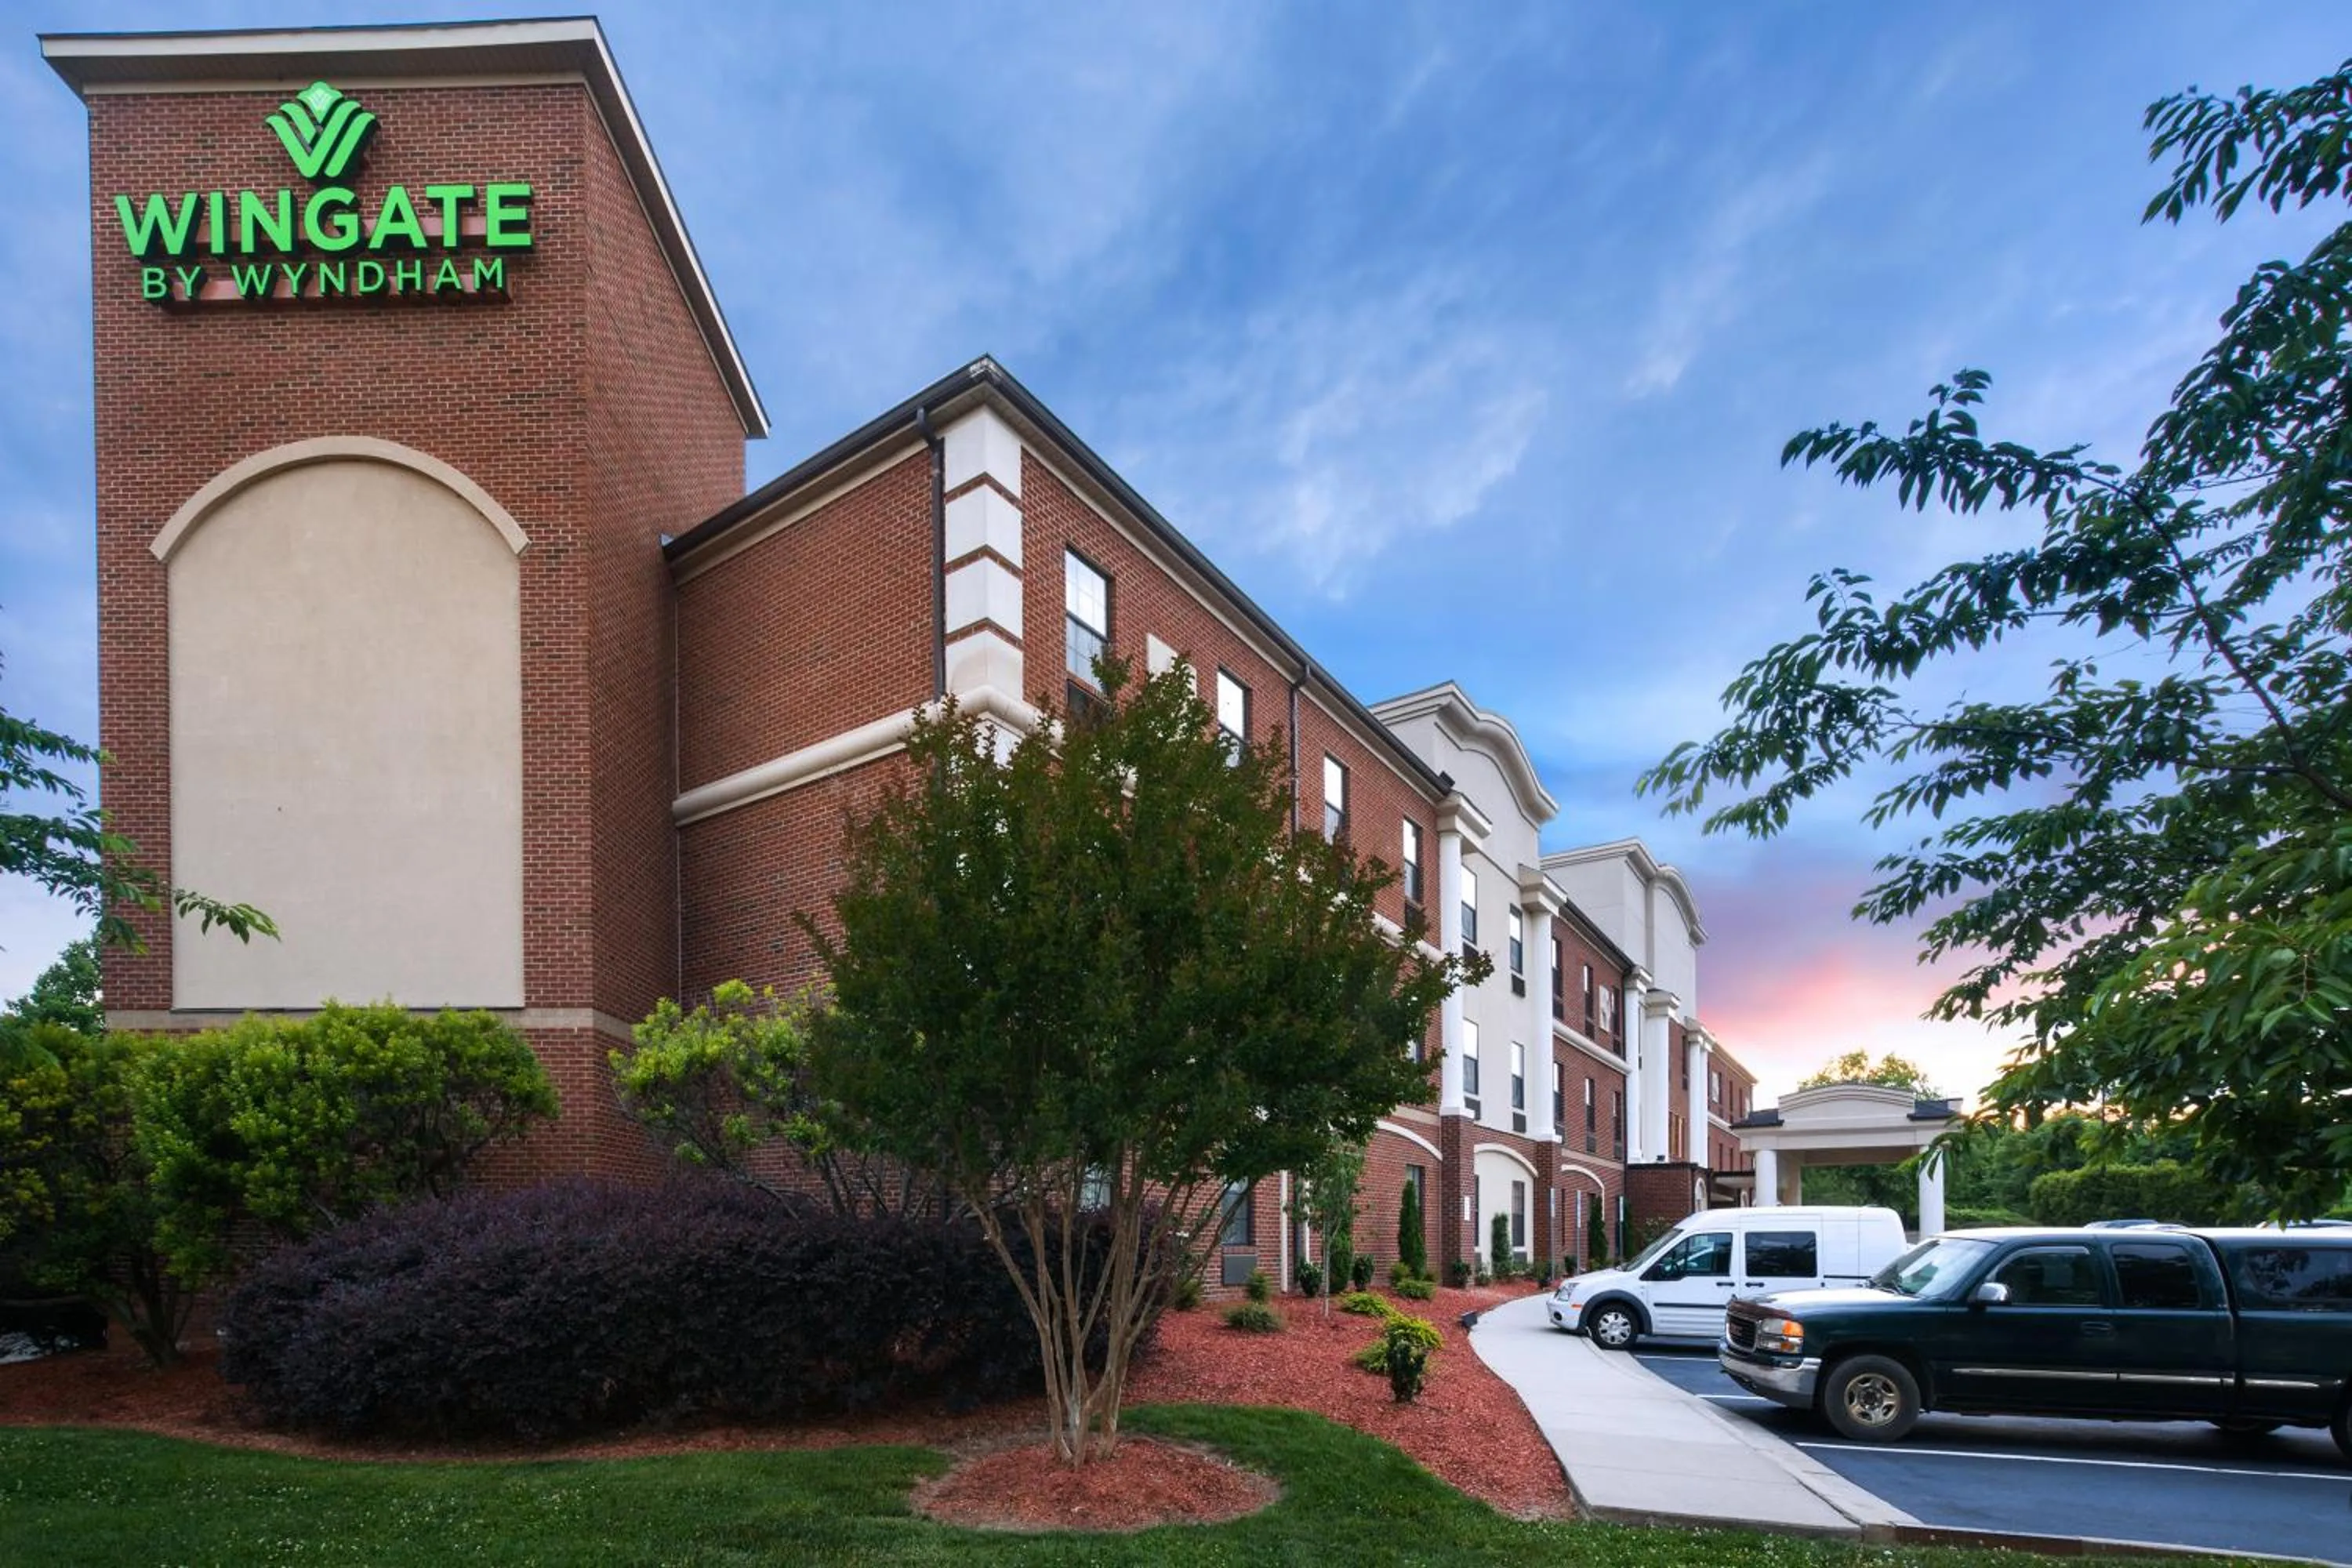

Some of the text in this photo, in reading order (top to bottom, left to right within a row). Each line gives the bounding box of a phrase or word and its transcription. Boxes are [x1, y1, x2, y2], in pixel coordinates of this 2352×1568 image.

[115, 183, 533, 256] WINGATE
[142, 257, 504, 299] BY WYNDHAM
